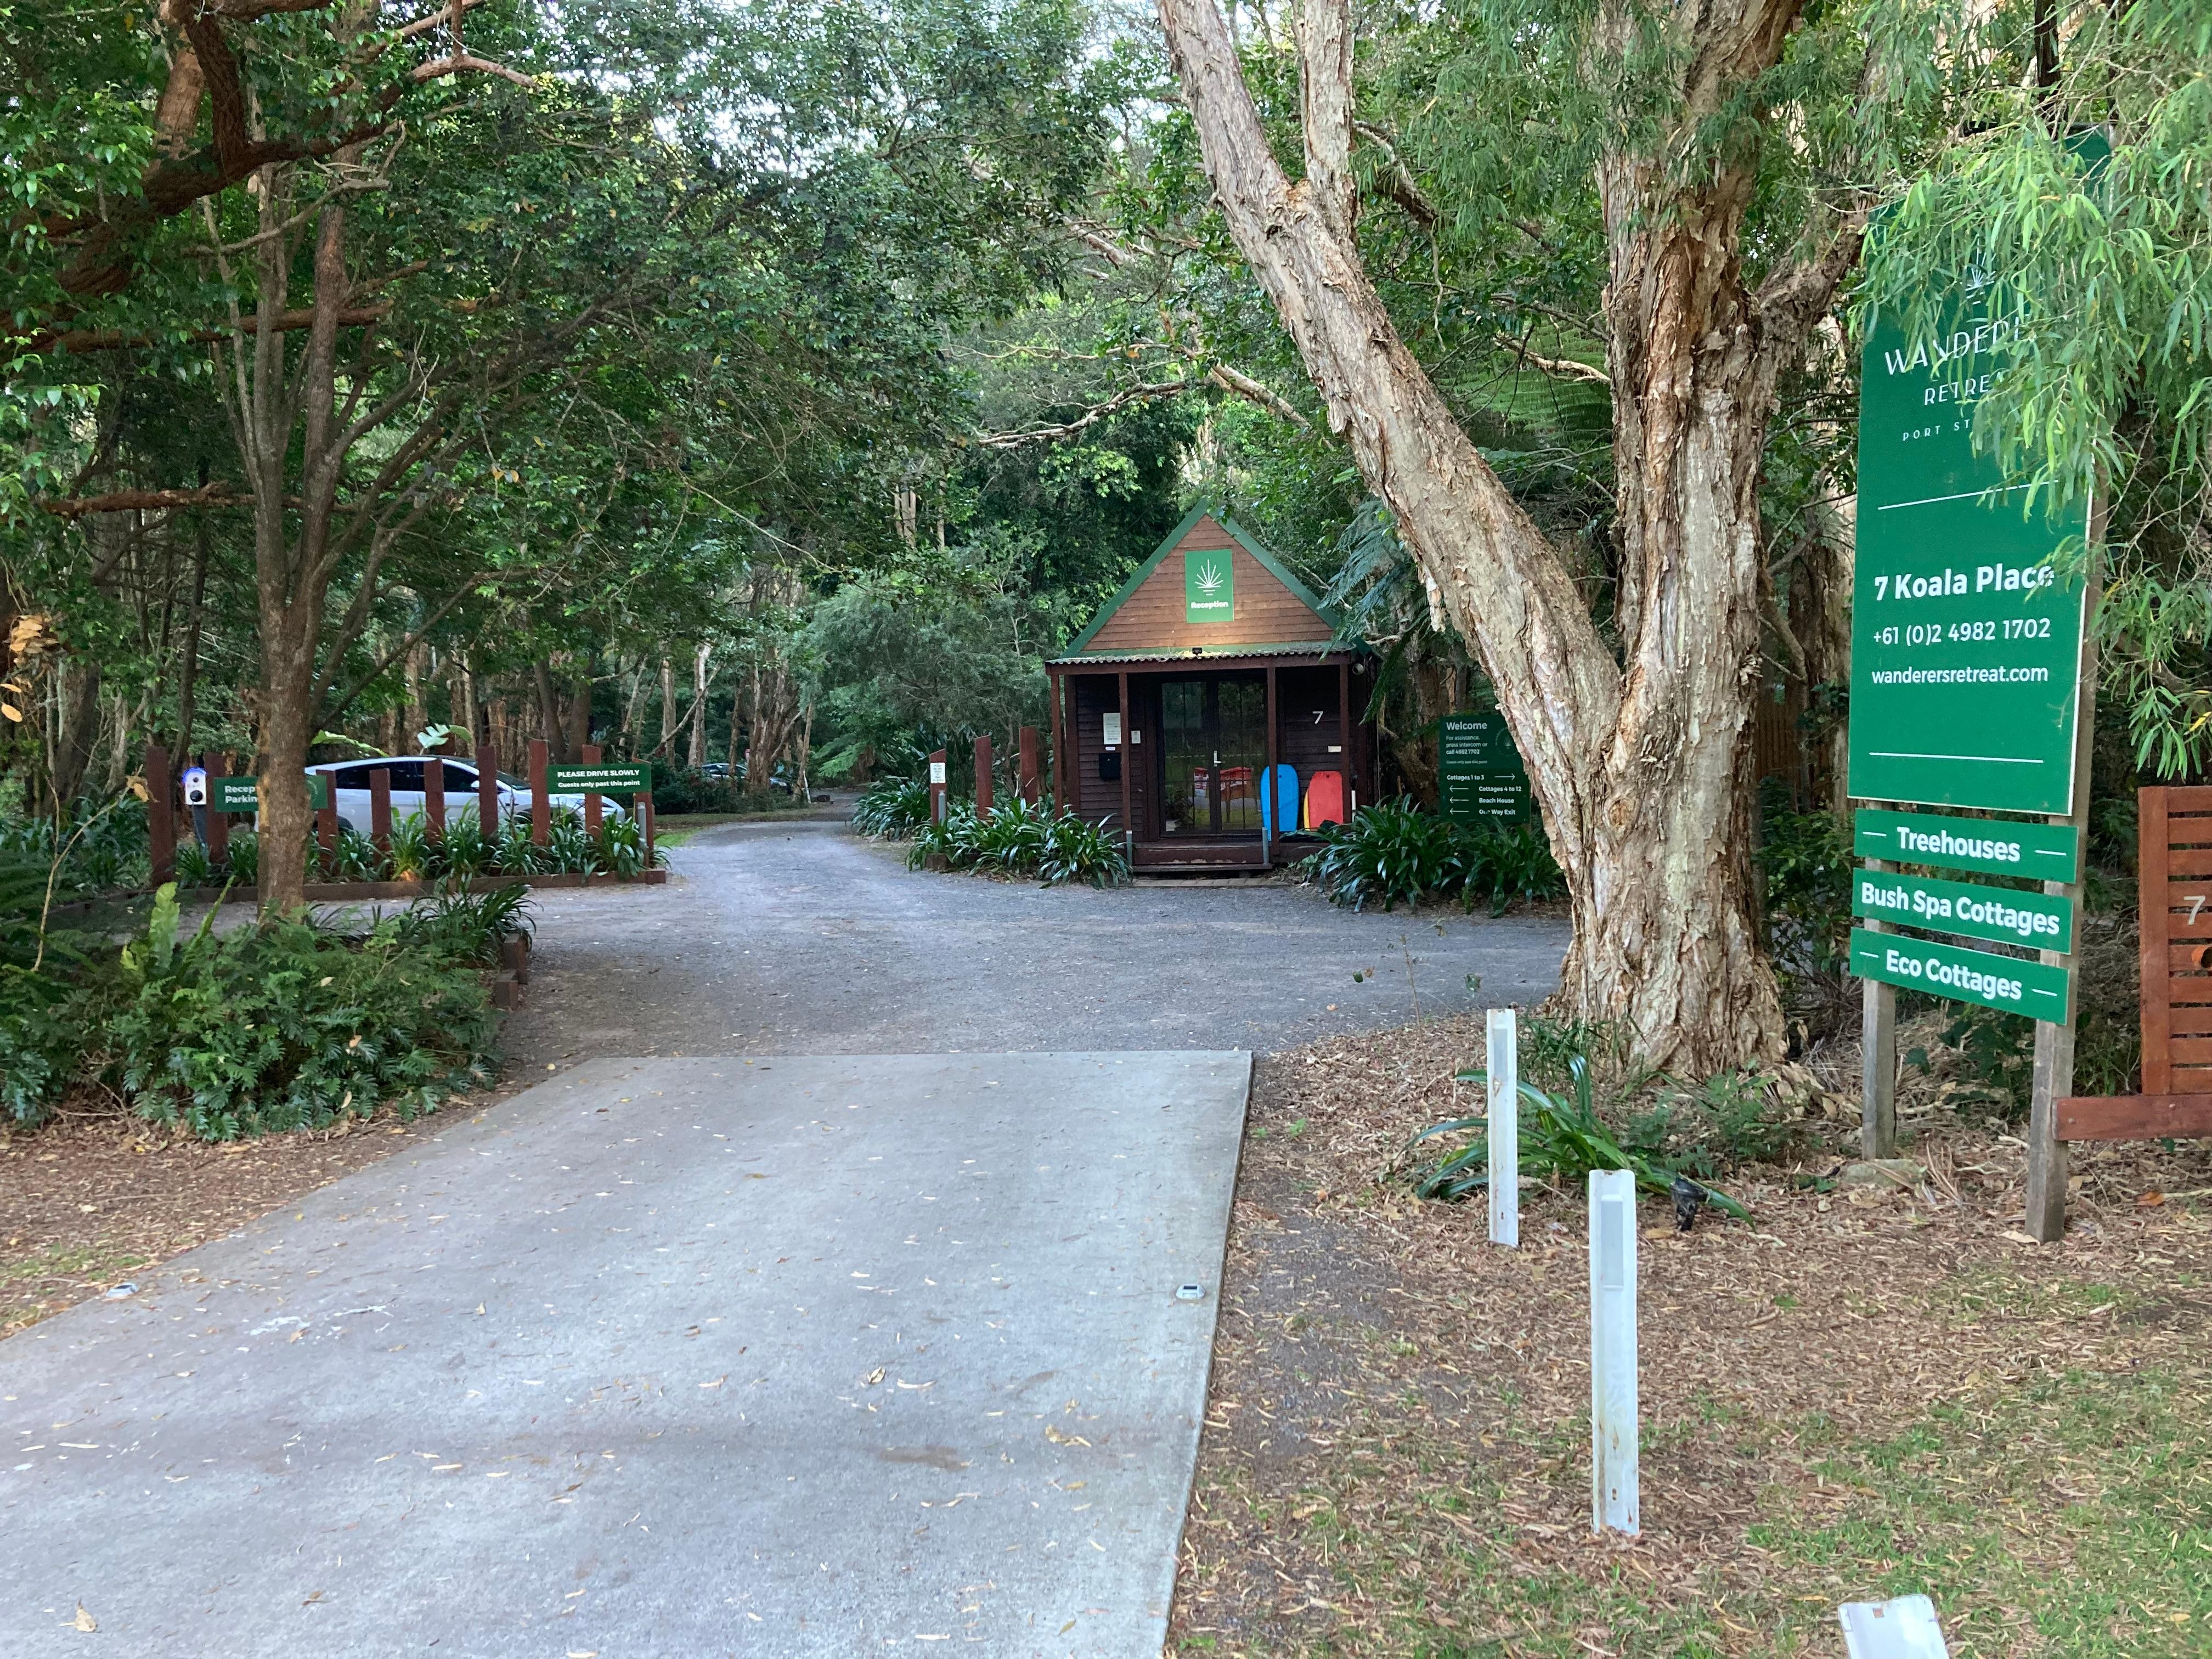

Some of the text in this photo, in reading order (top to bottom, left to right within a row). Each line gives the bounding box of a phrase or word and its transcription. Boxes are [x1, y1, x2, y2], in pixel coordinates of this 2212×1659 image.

[1924, 372, 2000, 406] RETRE
[1903, 425, 1940, 441] PORT
[1875, 563, 2055, 601] 7 Koala Place
[1190, 600, 1229, 610] Reception
[1873, 618, 2051, 646] +61 (0)2 4982 1702
[1872, 665, 2049, 684] wanderersretreat.com
[1312, 710, 1324, 724] 7
[1446, 721, 1487, 730] Welcome
[224, 786, 256, 794] Recep
[225, 795, 258, 803] Parkin
[1897, 827, 2021, 862] Treehouses
[1861, 882, 2060, 936] Bush Spa Cottages
[2183, 895, 2206, 926] 7
[1886, 949, 2022, 1000] Eco Cottages
